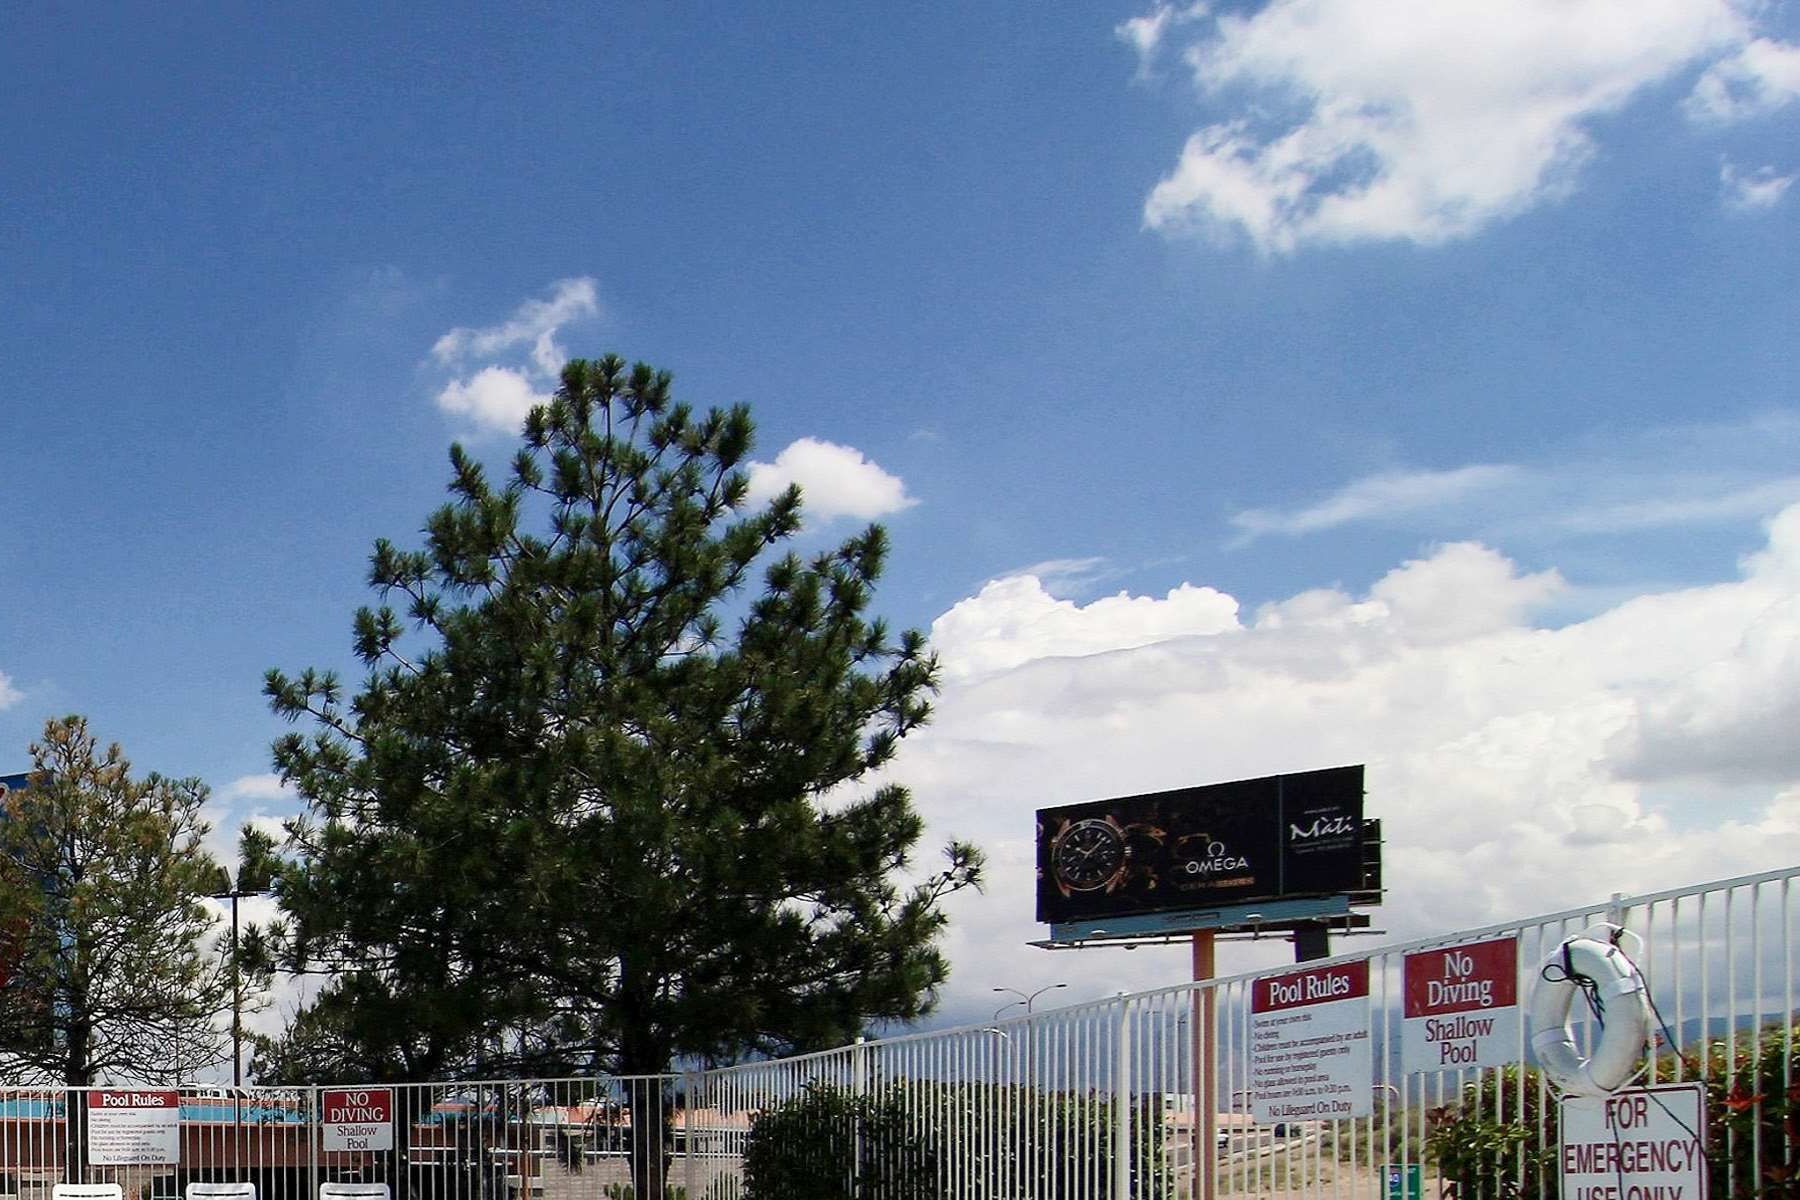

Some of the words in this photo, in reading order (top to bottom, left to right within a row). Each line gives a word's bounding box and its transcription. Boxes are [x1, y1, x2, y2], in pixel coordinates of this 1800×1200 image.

[1185, 856, 1249, 874] OMEGA
[1443, 951, 1473, 978] No
[1269, 978, 1302, 1006] Pool
[1306, 973, 1350, 1000] Rules
[1426, 977, 1494, 1007] Diving
[1425, 1016, 1494, 1042] Shallow
[1440, 1040, 1477, 1065] Pool
[102, 1093, 129, 1106] Pool
[132, 1094, 165, 1106] Rules
[345, 1092, 369, 1106] NO
[1269, 1105, 1280, 1116] No
[1282, 1103, 1315, 1117] Lifeguard
[1317, 1102, 1330, 1113] On
[1332, 1100, 1352, 1113] Duty
[331, 1107, 384, 1122] DIVING
[1605, 1096, 1649, 1129] FOR
[337, 1125, 377, 1136] Shallow
[347, 1138, 368, 1149] Pool
[1564, 1139, 1698, 1174] EMERGENCY
